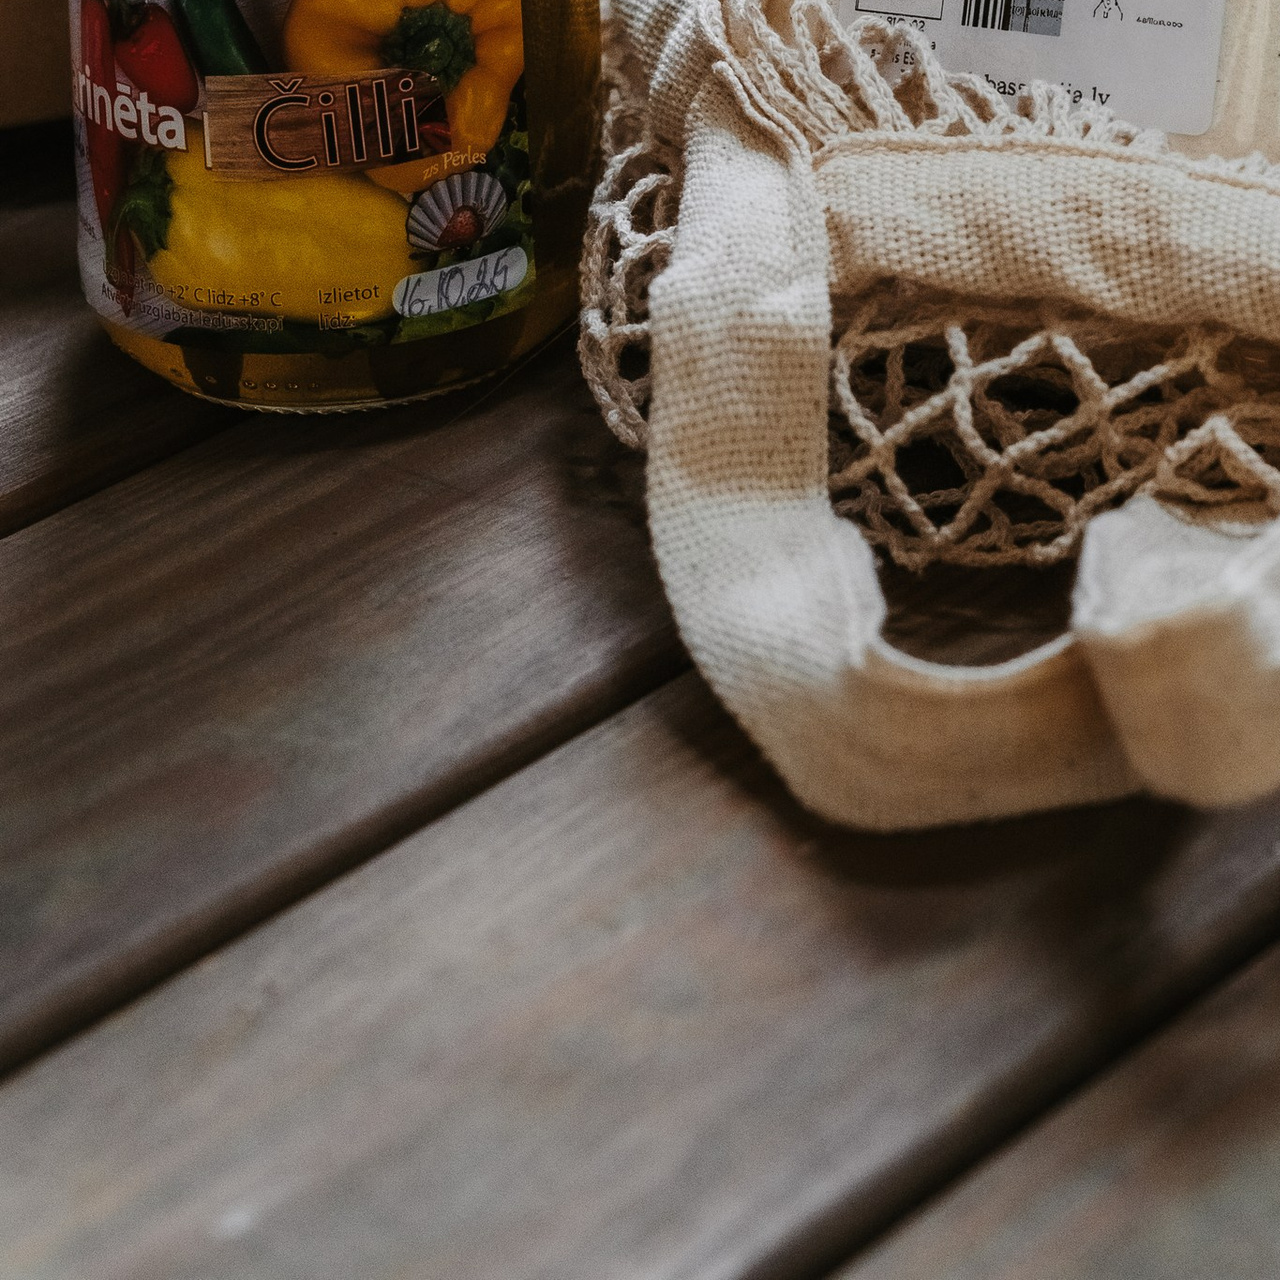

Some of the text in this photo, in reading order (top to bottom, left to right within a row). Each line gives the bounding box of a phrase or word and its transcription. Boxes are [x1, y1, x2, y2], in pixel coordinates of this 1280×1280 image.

[76, 64, 187, 151] rinēta
[253, 77, 420, 172] Čilli
[442, 144, 487, 170] Pērles
[148, 281, 165, 296] no
[207, 288, 235, 306] līdz
[318, 284, 380, 305] Izlietot
[139, 300, 196, 325] uzglabāt
[318, 312, 357, 331] līdz:
